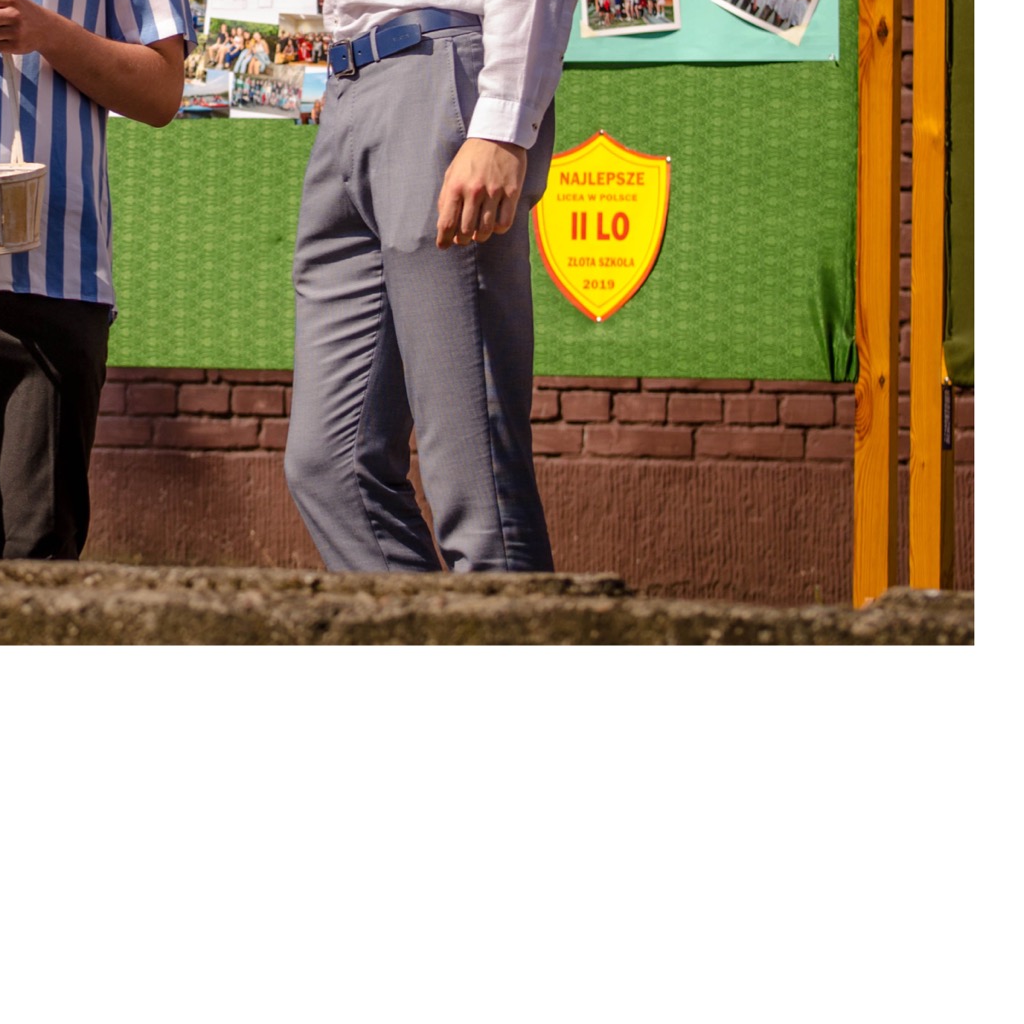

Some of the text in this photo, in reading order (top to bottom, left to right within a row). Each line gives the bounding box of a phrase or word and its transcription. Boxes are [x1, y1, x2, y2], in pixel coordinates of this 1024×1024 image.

[559, 171, 645, 186] NAJLEPSZE
[556, 193, 638, 202] LICEA W POLSCE
[571, 211, 630, 241] II LO
[567, 256, 635, 267] ZŁOTA SZKOŁA
[582, 279, 615, 290] 2019
